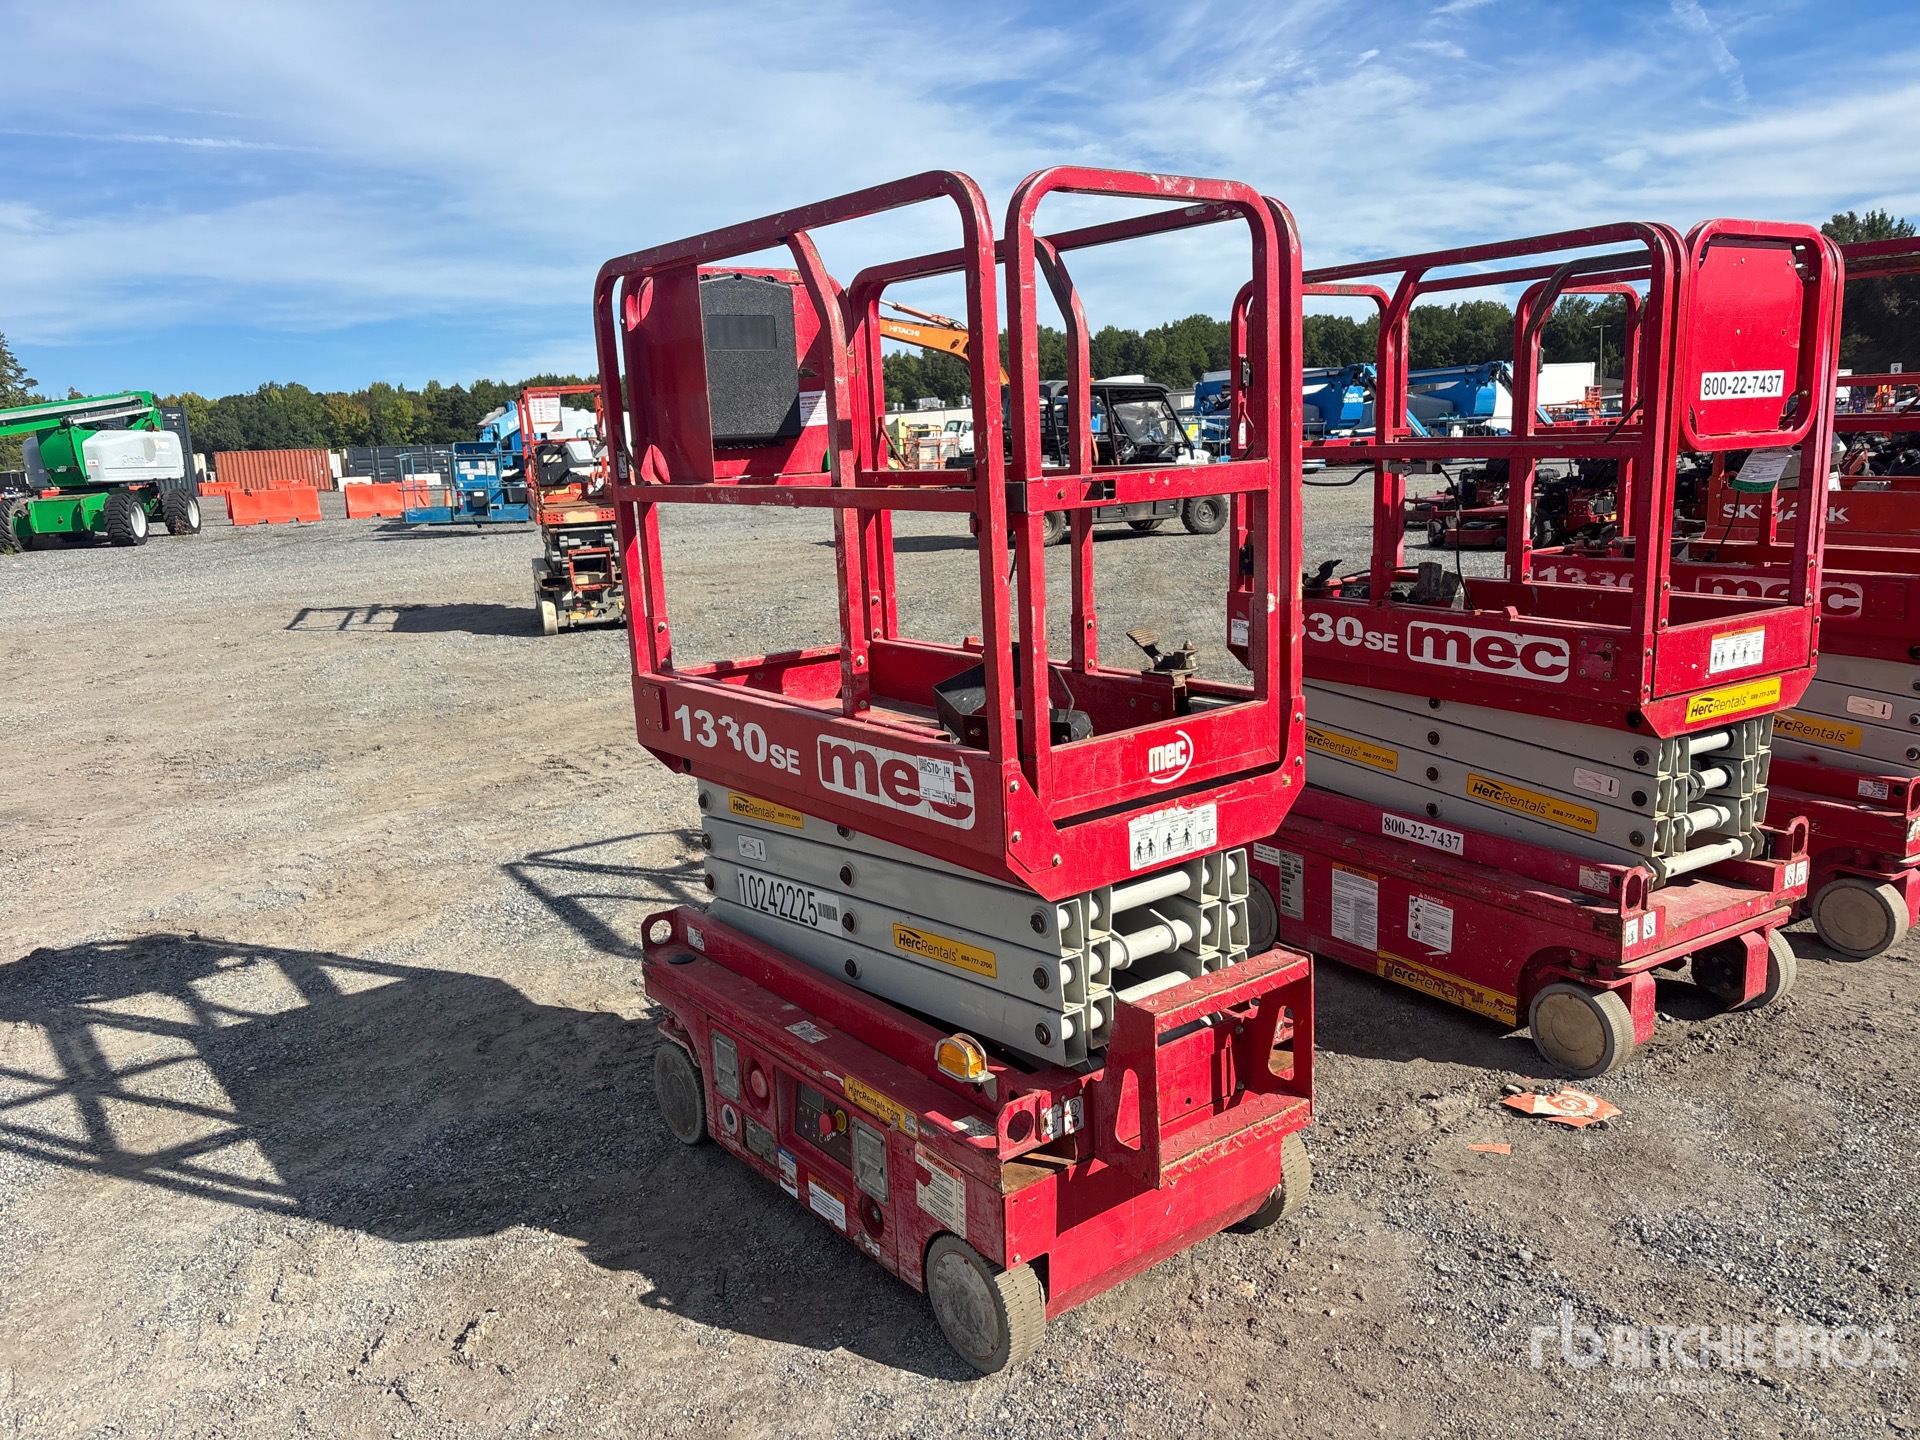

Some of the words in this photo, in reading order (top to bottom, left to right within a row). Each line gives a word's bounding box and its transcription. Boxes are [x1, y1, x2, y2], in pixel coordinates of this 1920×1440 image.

[889, 325, 920, 337] HITACHI
[1703, 374, 1782, 396] 800-22-7437
[1410, 624, 1570, 676] mec
[1690, 695, 1747, 717] HercRentals
[1149, 740, 1186, 773] mec
[1362, 751, 1393, 765] 888-777-2700
[733, 799, 775, 819] HercRentals
[1473, 782, 1547, 815] HercRentals
[1552, 808, 1593, 825] 888-777-2700
[1384, 817, 1460, 850] 800-22-7437
[740, 873, 818, 926] 10242225
[1424, 894, 1443, 905] DANGER
[899, 932, 957, 961] HercRentals
[960, 954, 992, 970] 888-777-2700
[925, 1150, 955, 1176] IMPORTANT
